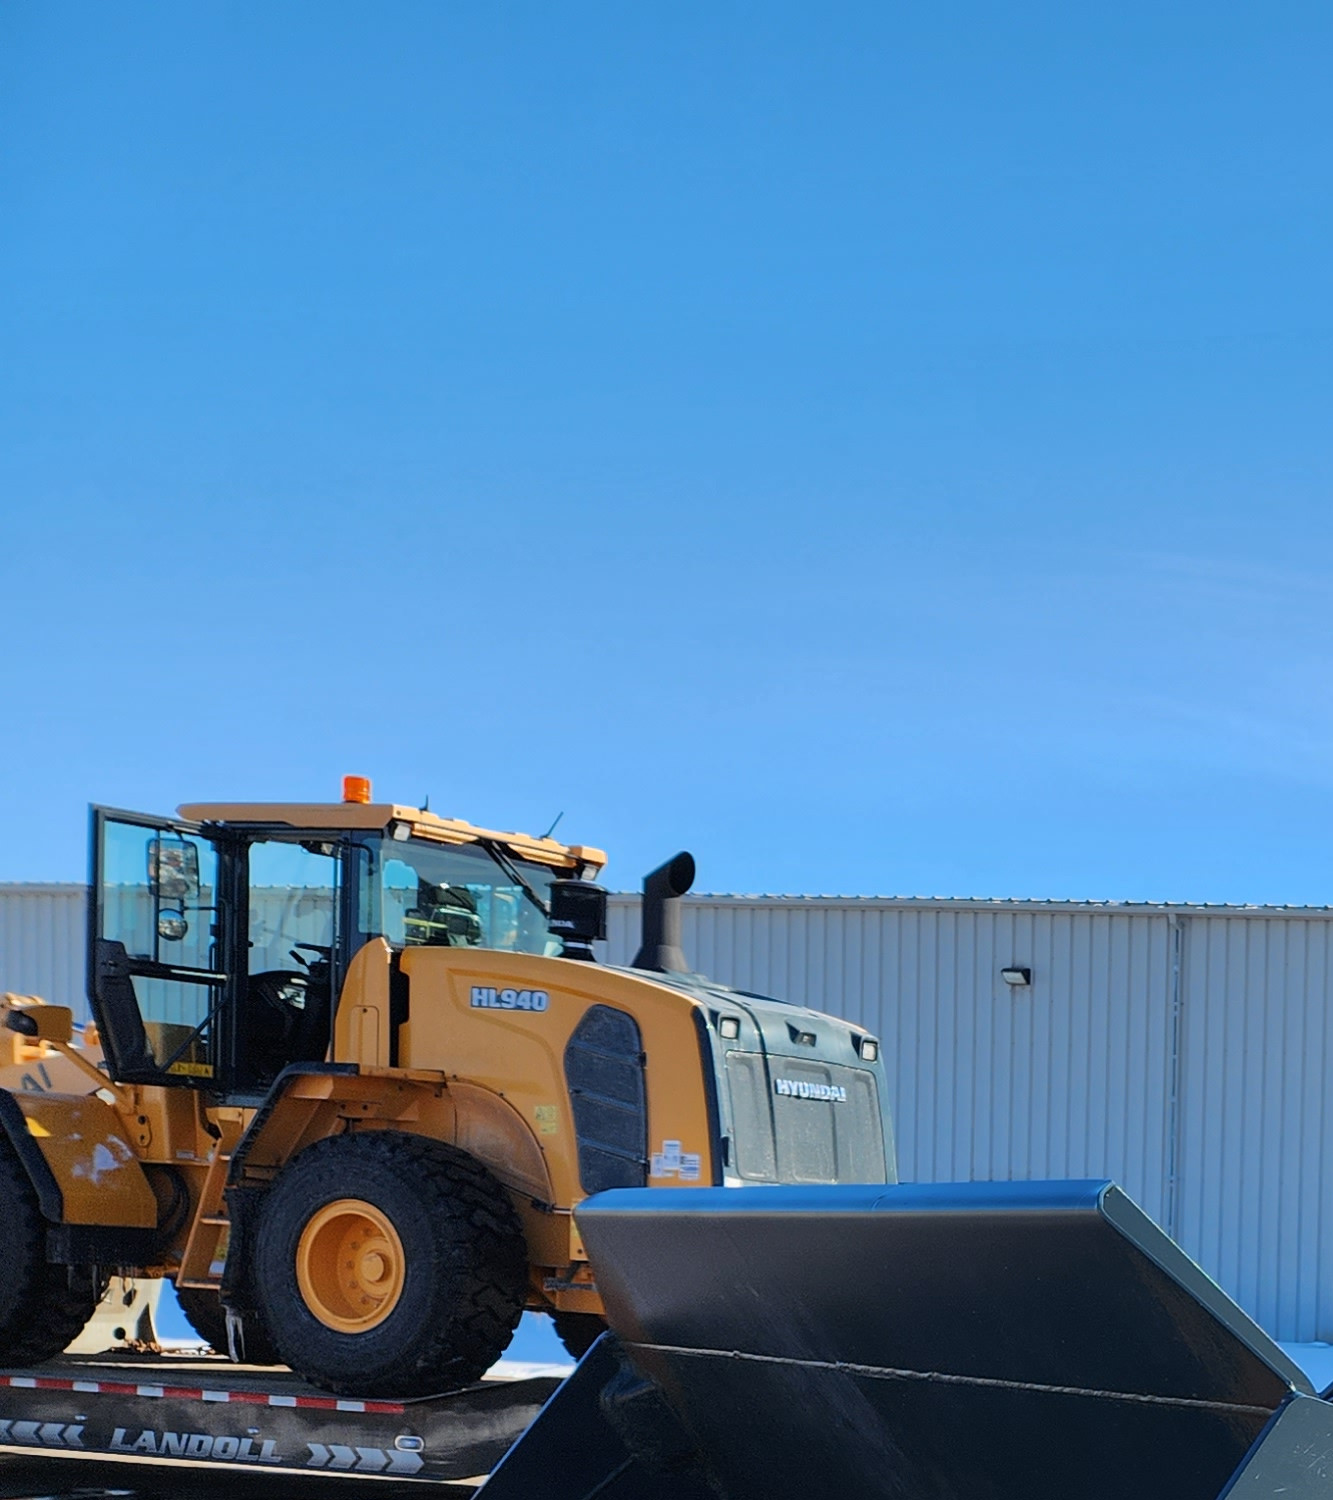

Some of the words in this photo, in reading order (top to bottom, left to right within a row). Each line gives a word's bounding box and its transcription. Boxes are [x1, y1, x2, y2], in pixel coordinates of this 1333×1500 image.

[471, 986, 549, 1012] HL940
[775, 1079, 847, 1102] HYUNDAI
[109, 1427, 282, 1463] LANDOLL
